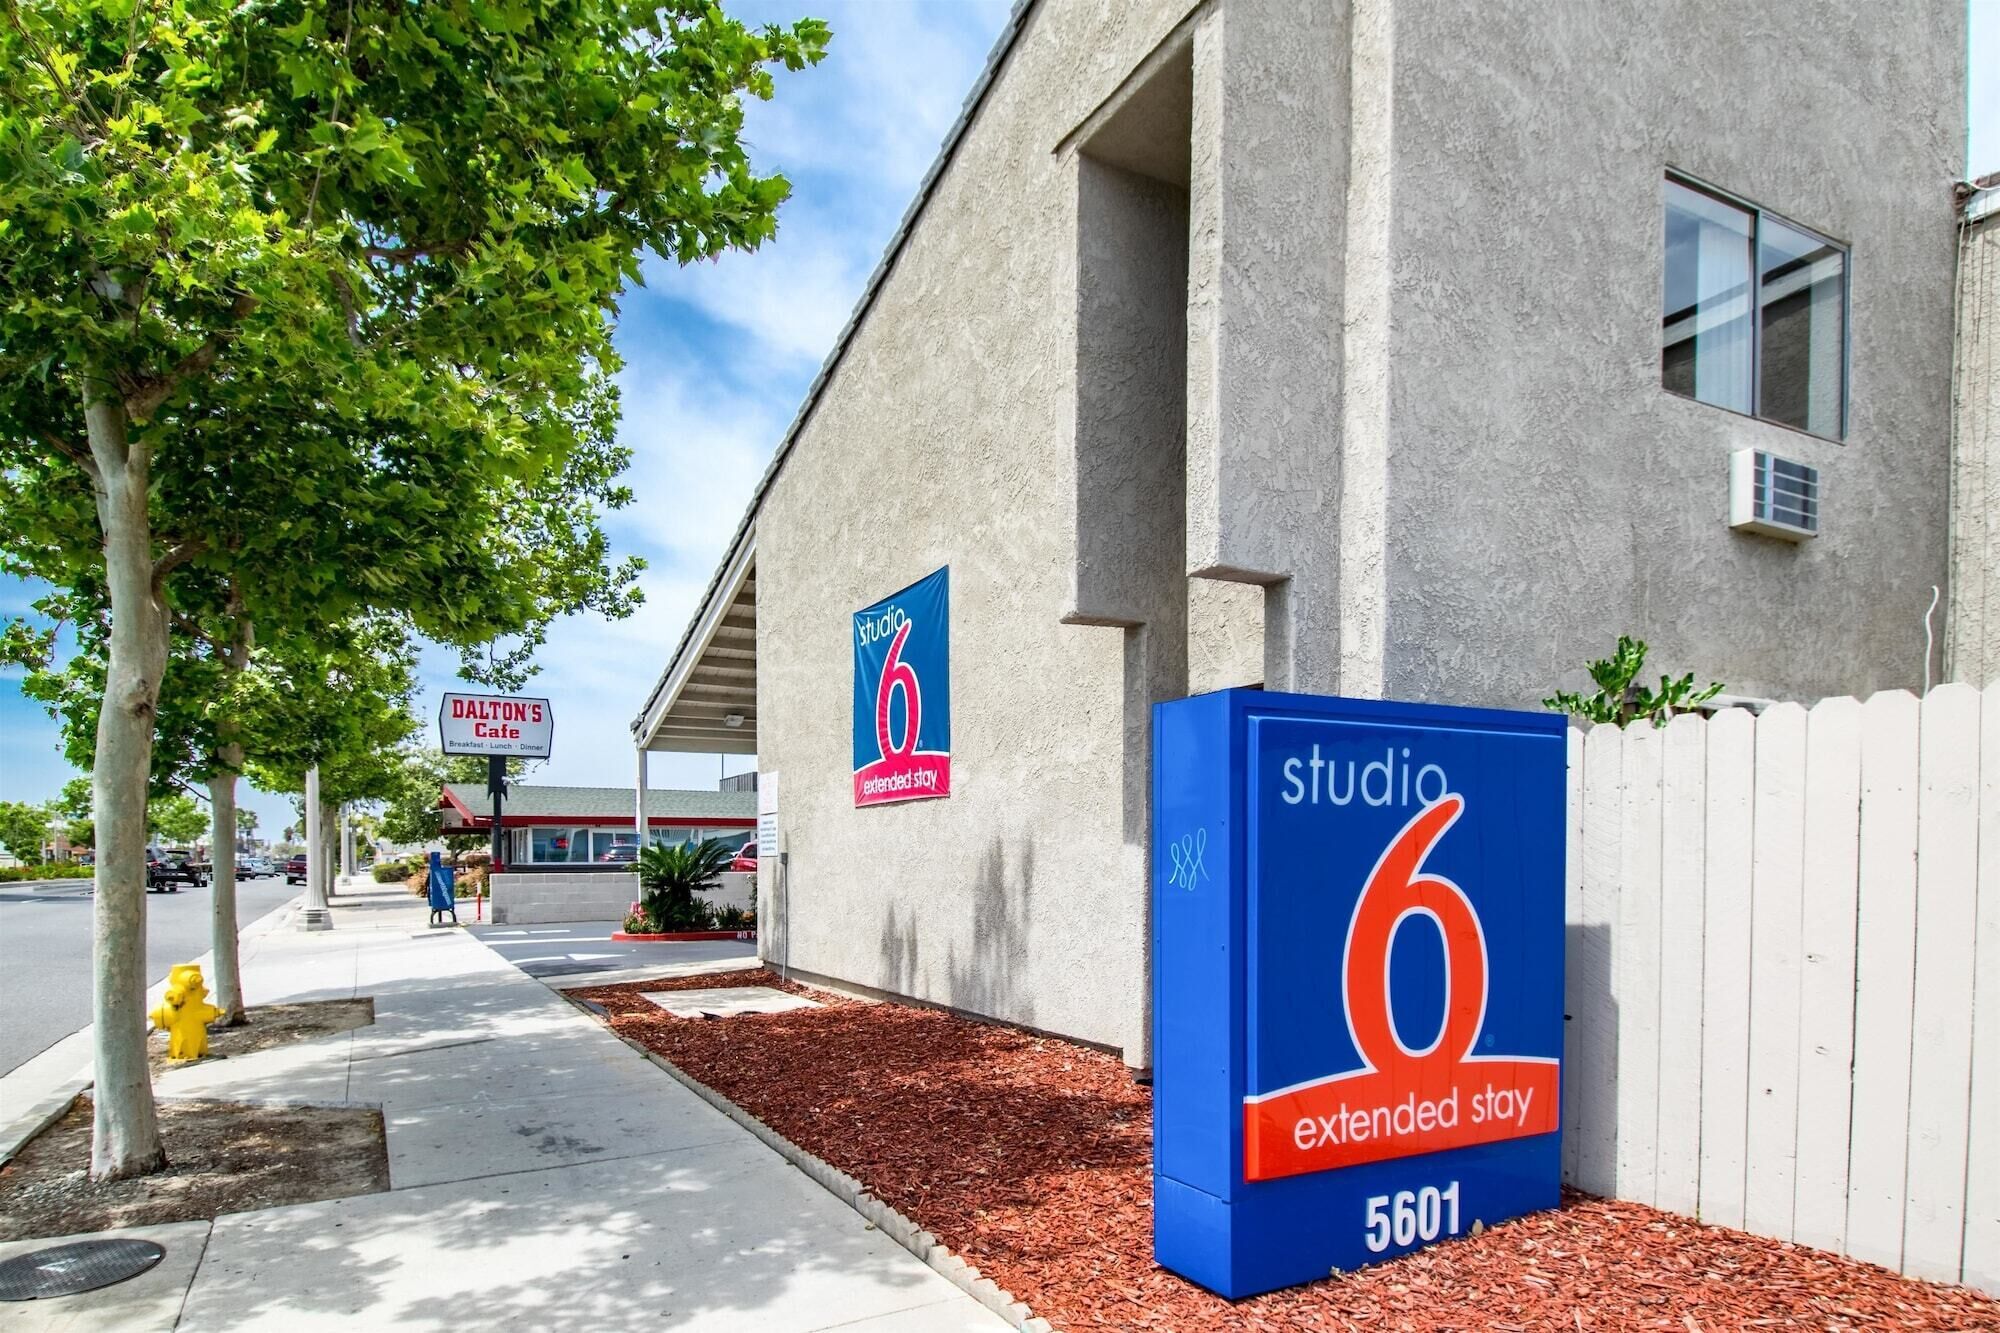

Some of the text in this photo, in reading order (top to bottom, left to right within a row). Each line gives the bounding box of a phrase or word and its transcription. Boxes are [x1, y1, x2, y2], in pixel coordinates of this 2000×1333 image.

[860, 605, 905, 646] studio
[452, 699, 542, 723] DALTON'S
[876, 618, 922, 758] 6
[449, 740, 484, 748] Breakfast
[520, 743, 544, 751] Dinner
[474, 722, 520, 739] Cafe
[863, 767, 938, 795] extended stay
[1281, 744, 1448, 807] studio
[1342, 792, 1489, 1070] 6
[1294, 1083, 1534, 1151] extended stay
[1364, 1181, 1460, 1252] 5601
